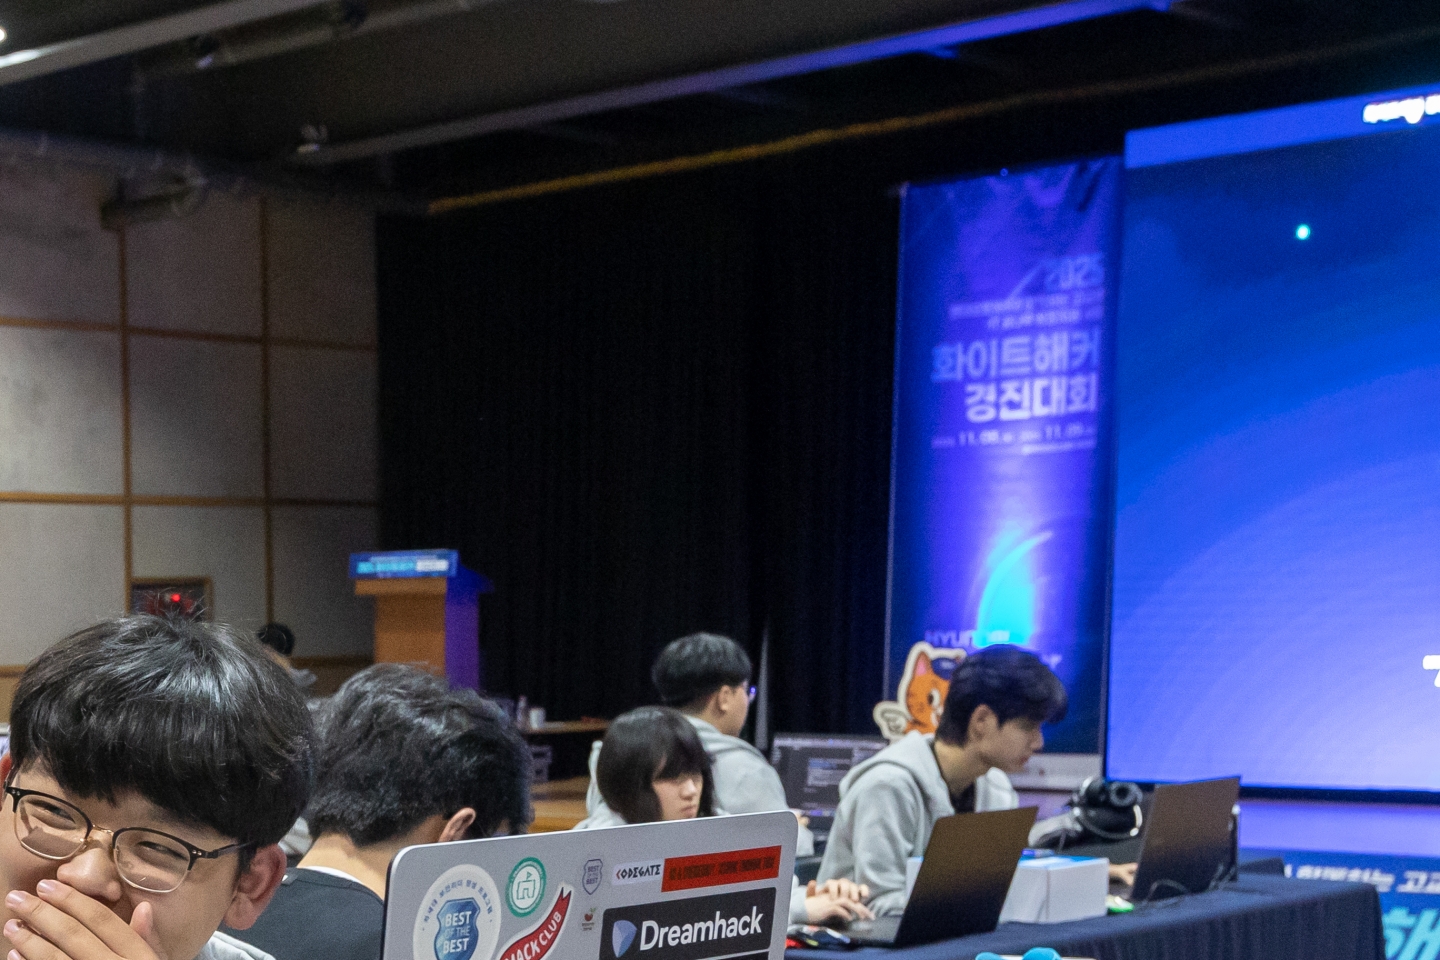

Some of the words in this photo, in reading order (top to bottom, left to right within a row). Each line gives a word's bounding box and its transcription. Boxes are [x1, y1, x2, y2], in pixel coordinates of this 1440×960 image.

[931, 326, 1101, 382] 화이트해커
[965, 372, 1098, 423] 경진대회
[445, 911, 472, 927] BEST
[456, 926, 470, 937] THE
[538, 911, 562, 946] CLUB
[639, 905, 764, 951] Dreamhack
[443, 937, 469, 954] BEST
